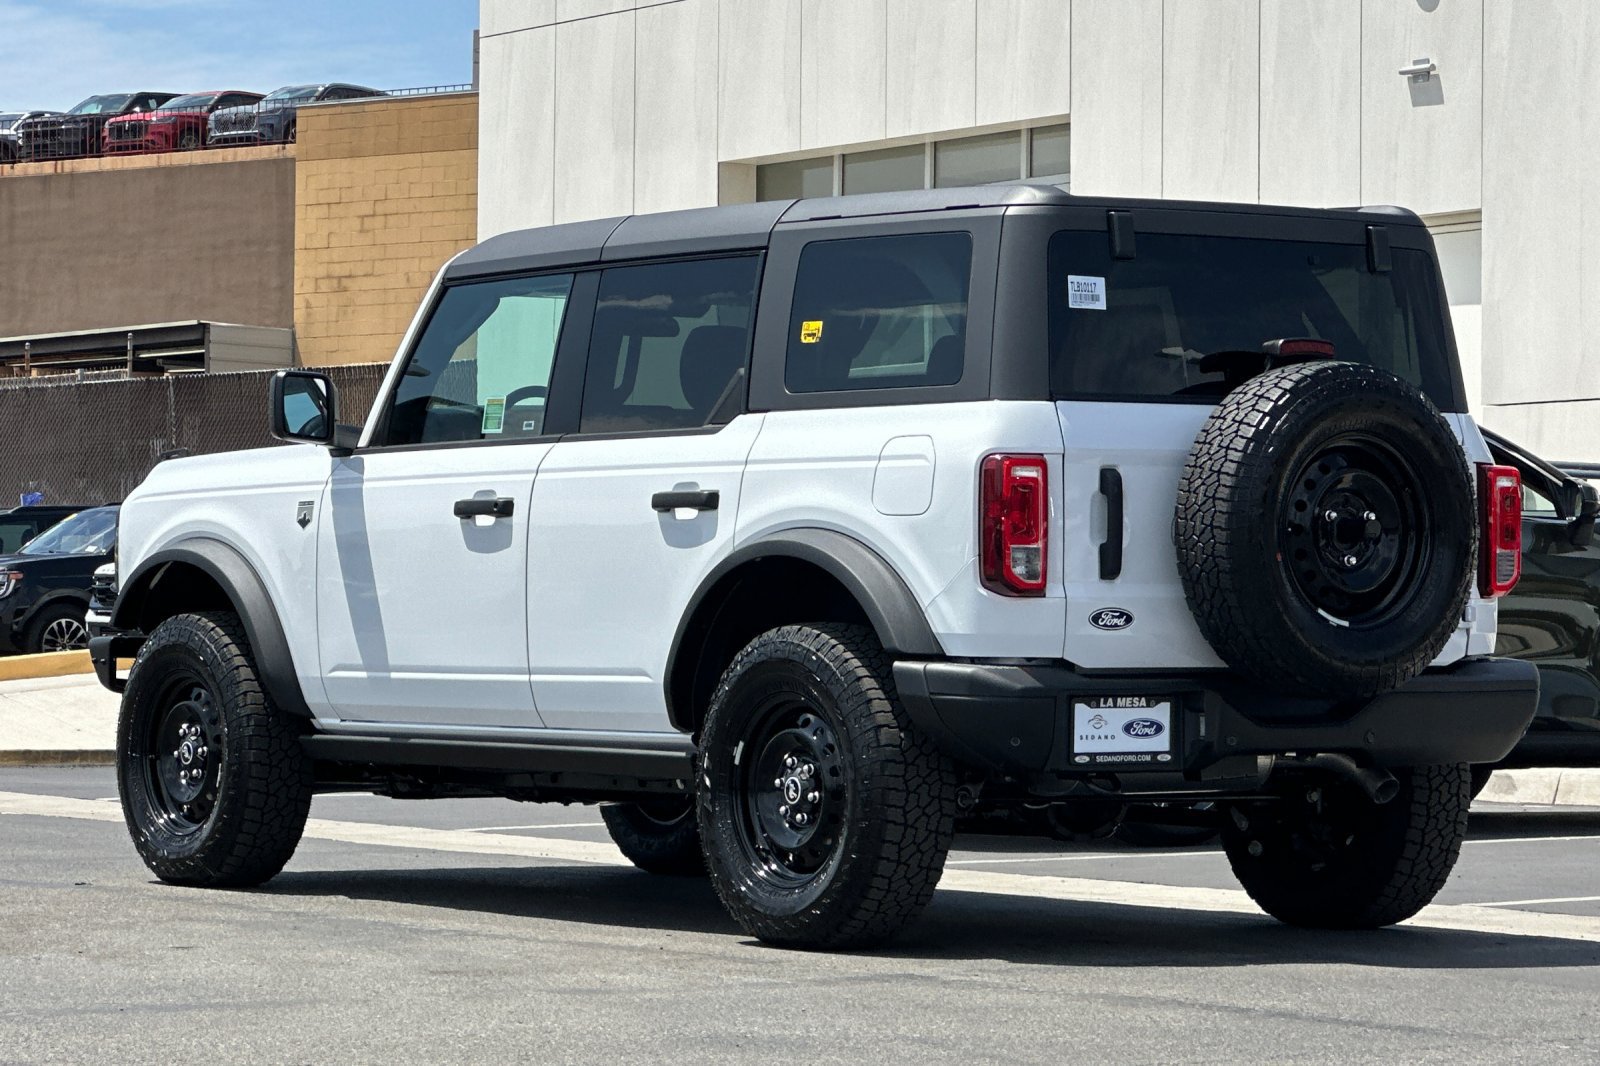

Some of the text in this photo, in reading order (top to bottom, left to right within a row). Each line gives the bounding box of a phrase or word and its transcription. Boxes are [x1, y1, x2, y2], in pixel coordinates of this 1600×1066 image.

[1070, 281, 1097, 293] TLB10117
[1098, 611, 1127, 626] Ford
[1100, 697, 1147, 708] LA MESA
[1130, 721, 1157, 735] Ford
[1095, 754, 1152, 763] SEDANOFORD.COM
